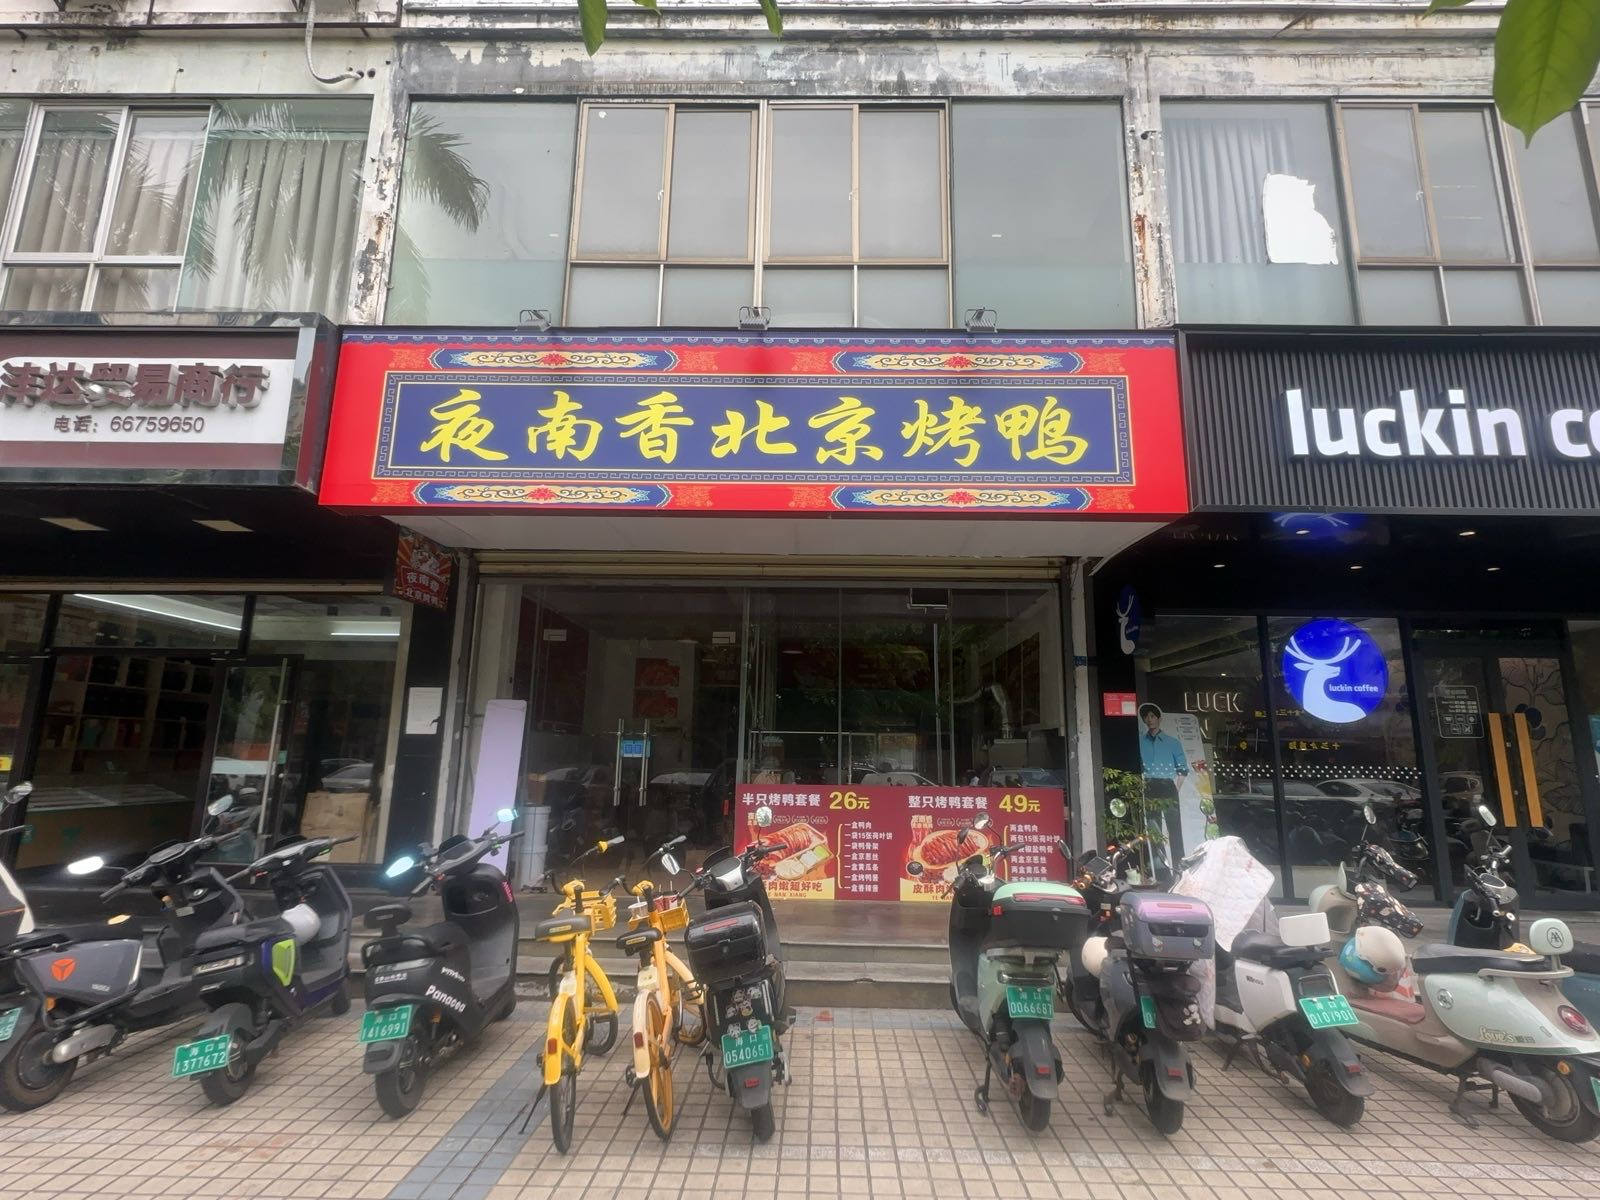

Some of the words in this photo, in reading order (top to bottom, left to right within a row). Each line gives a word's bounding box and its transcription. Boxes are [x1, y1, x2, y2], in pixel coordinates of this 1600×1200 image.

[420, 389, 1089, 467] 夜南香北京烤鸭
[1286, 389, 1527, 457] luckin
[1329, 684, 1353, 692] luckin
[1354, 684, 1379, 692] coffee
[1184, 692, 1244, 713] LUCK
[742, 792, 821, 807] 半只烤鸭套餐
[829, 791, 870, 810] 26元
[908, 795, 988, 810] 整只烤鸭套餐
[999, 794, 1041, 813] 49元
[844, 821, 872, 829] 一盒鸭肉
[1009, 824, 1039, 833] 两盒鸭肉
[844, 863, 879, 872] 一盒黄瓜条
[1011, 866, 1048, 875] 两盒黄瓜条
[175, 1052, 226, 1074] 1377672
[725, 1043, 770, 1064] 0540651
